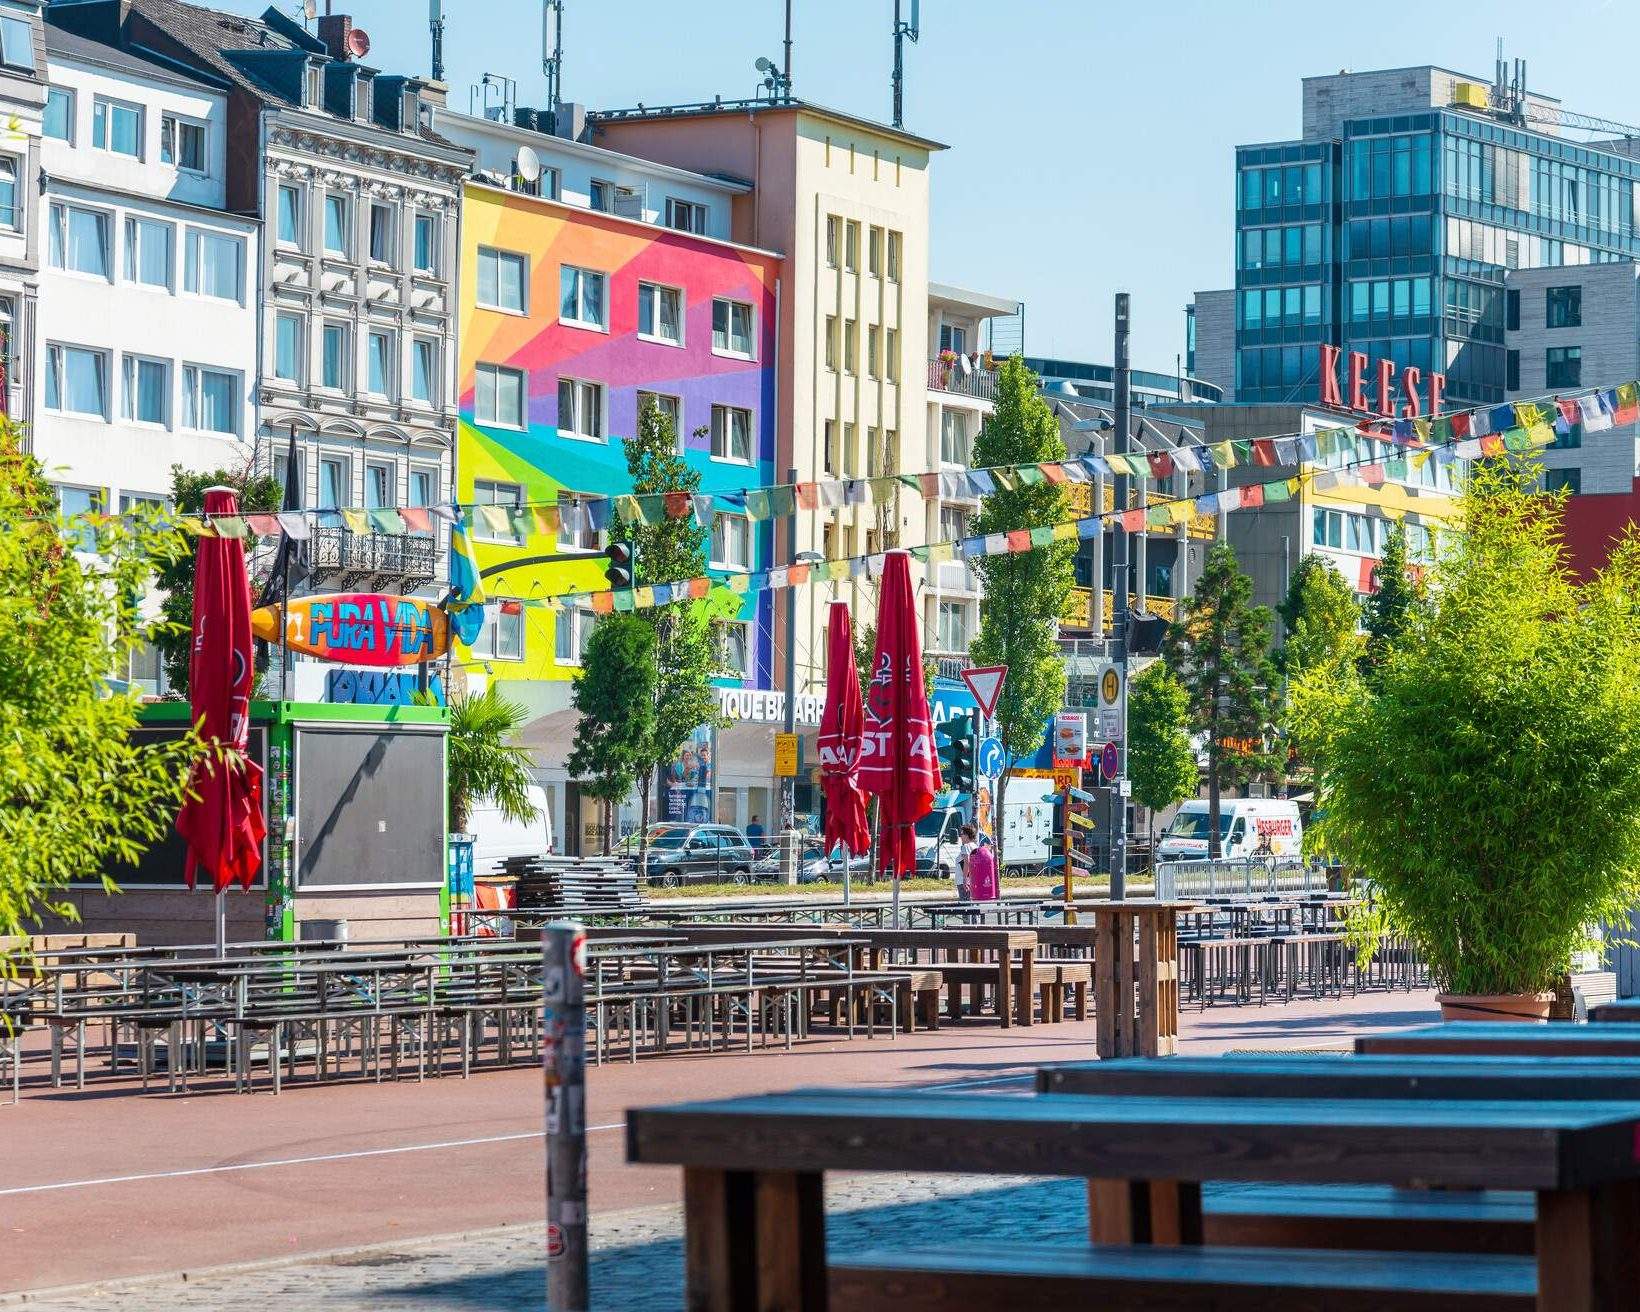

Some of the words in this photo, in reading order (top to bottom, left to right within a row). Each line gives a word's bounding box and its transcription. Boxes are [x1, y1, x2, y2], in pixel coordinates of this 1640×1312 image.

[1320, 343, 1446, 418] KEESE
[309, 602, 376, 650] PURA
[379, 599, 434, 655] VIDA
[719, 690, 764, 721] IQUE
